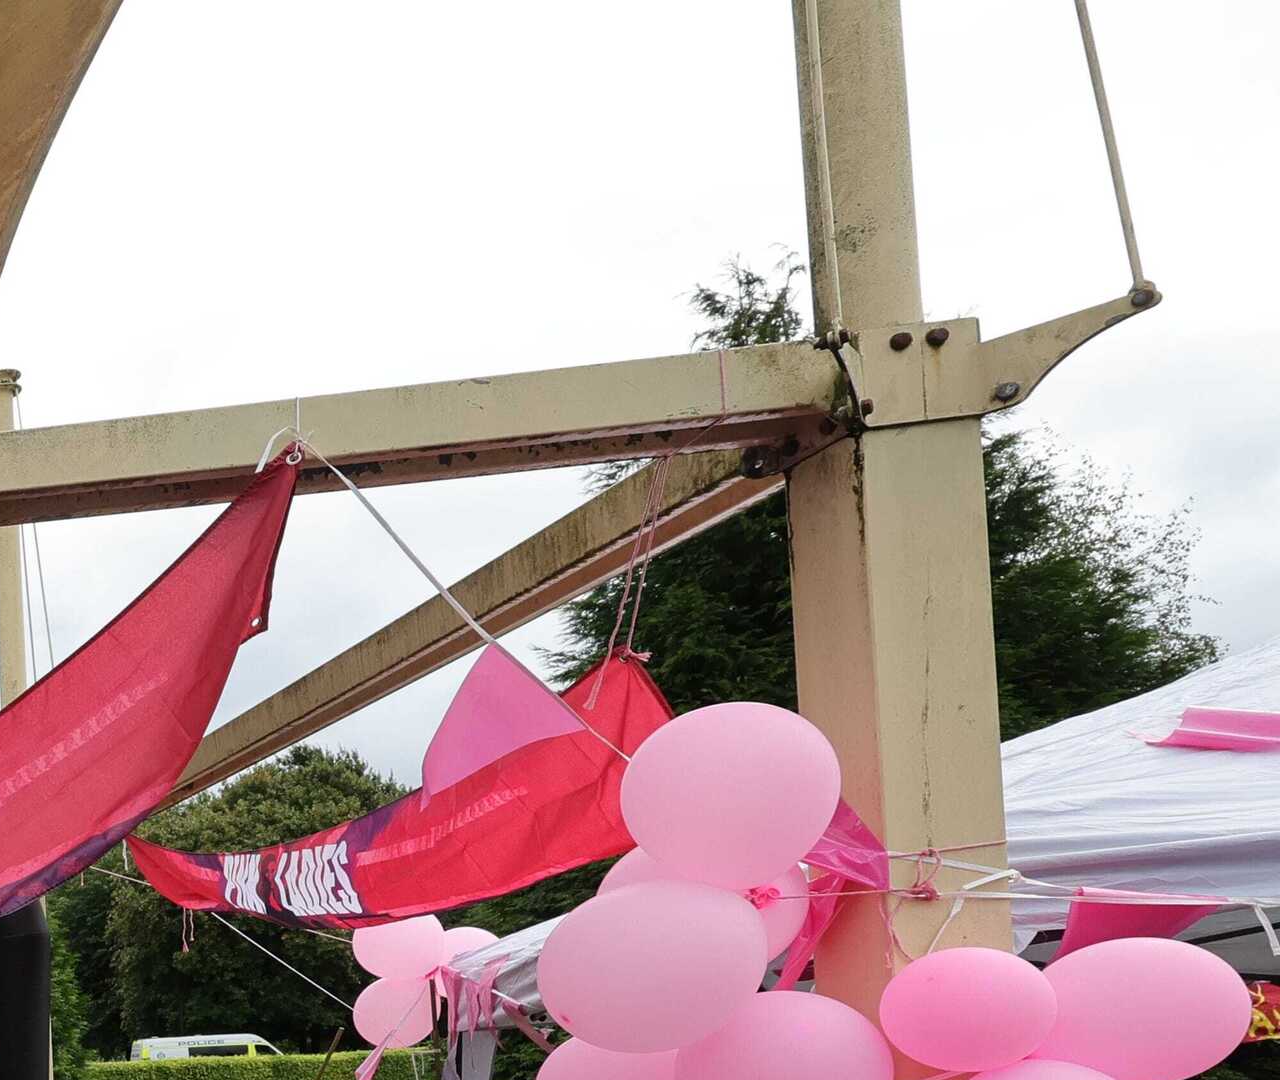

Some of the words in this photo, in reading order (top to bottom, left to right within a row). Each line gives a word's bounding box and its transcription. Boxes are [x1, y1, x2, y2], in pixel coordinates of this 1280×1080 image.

[224, 854, 268, 915] PINK
[275, 840, 363, 917] LADIES
[177, 1039, 225, 1047] POLICE
